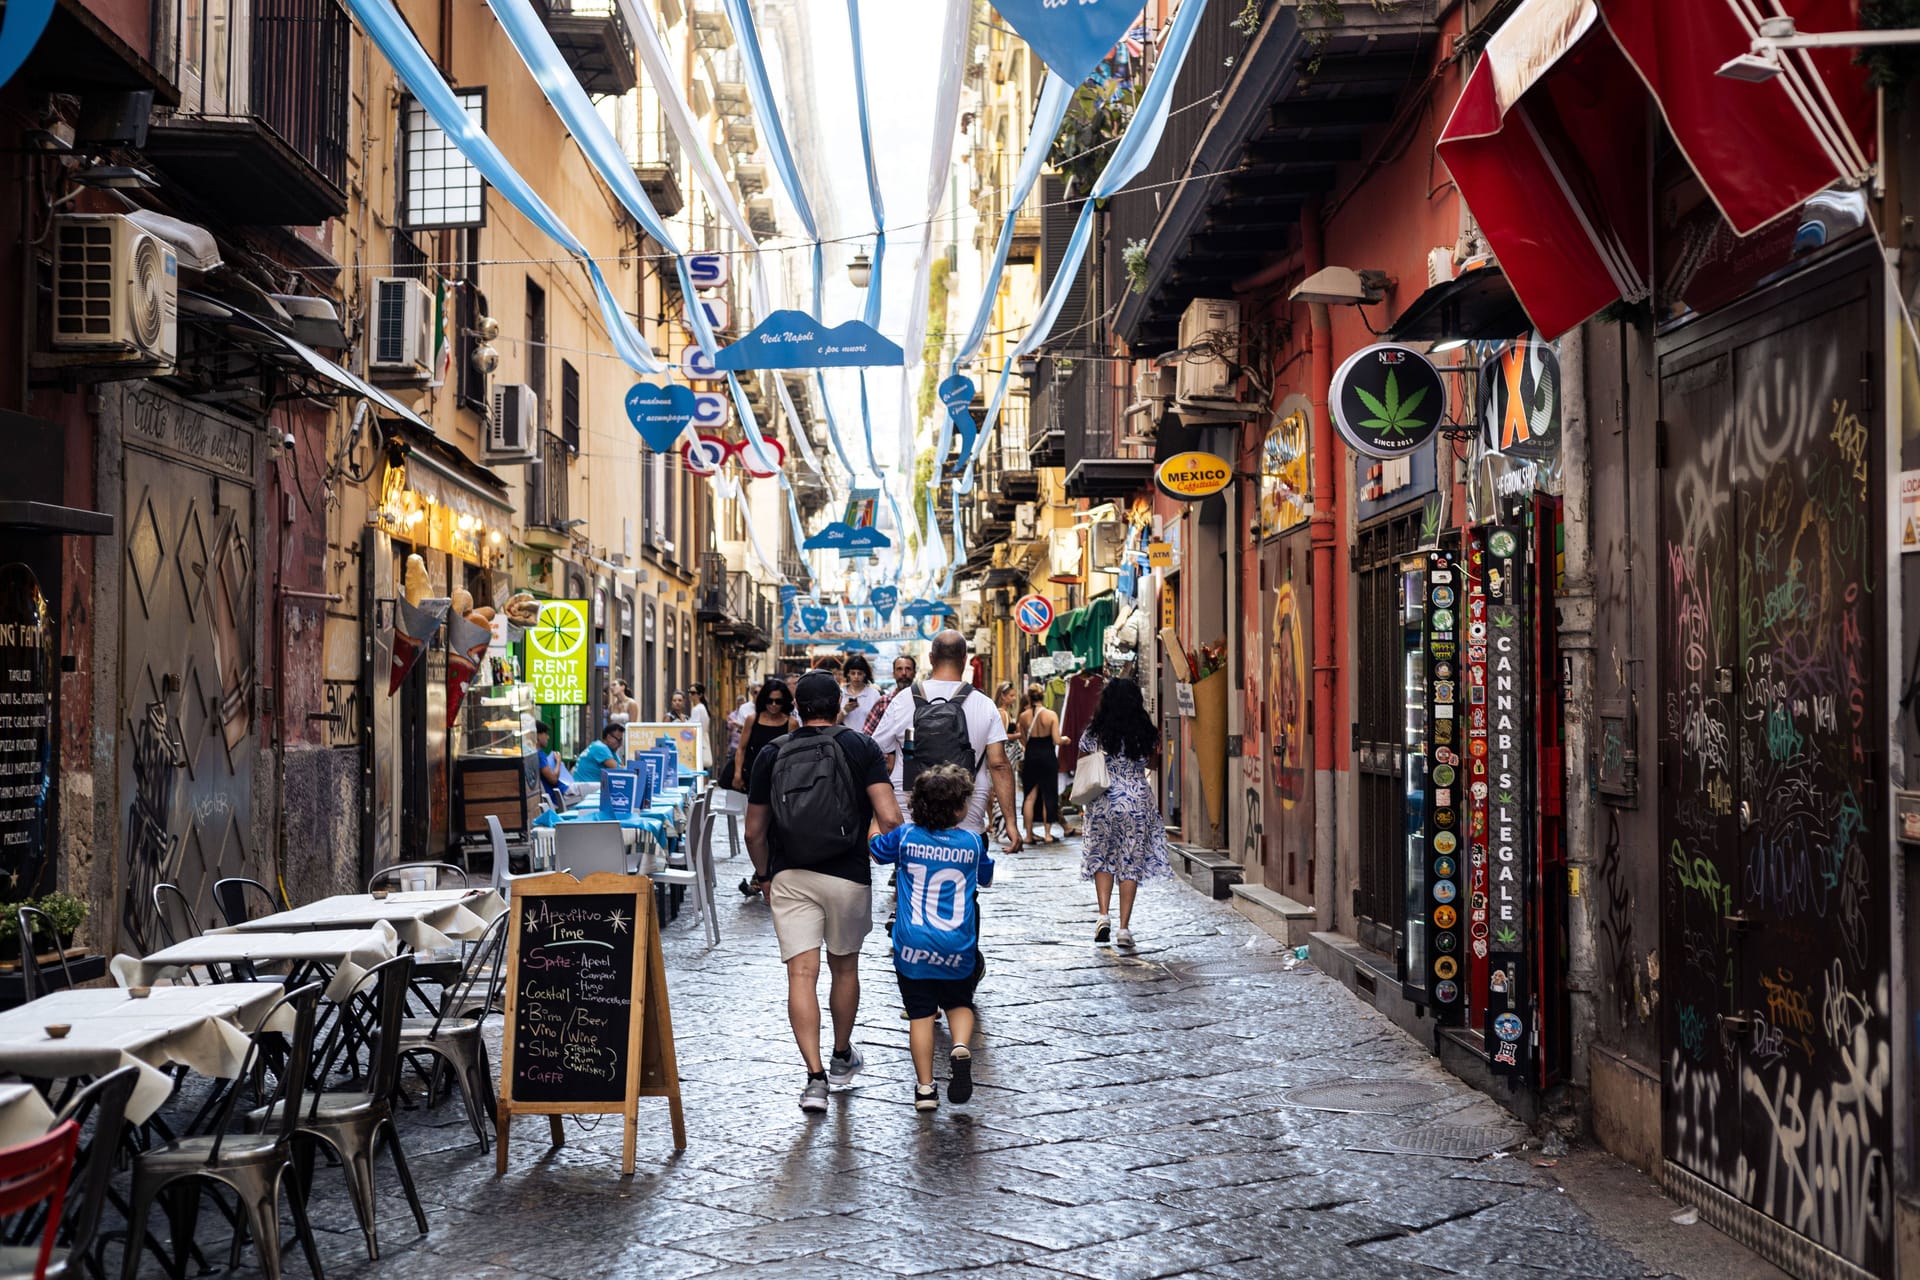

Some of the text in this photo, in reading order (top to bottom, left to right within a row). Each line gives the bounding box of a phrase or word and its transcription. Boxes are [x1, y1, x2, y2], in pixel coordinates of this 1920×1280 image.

[760, 331, 815, 344] Vedi Napoli
[841, 343, 869, 353] muori
[1378, 351, 1406, 362] NXS
[1373, 437, 1396, 448] SINCE
[1168, 469, 1226, 483] MEXICO
[1153, 551, 1171, 559] ATM
[533, 659, 579, 673] RENT
[532, 674, 579, 688] TOUR
[1497, 636, 1512, 789] CANNABIS
[906, 842, 975, 864] MARADONA
[1498, 807, 1513, 920] LEGALE
[907, 863, 967, 931] 10
[540, 899, 602, 924] Aperitivo
[548, 922, 585, 941] Time
[581, 952, 611, 969] Aperol
[580, 968, 617, 981] Campari
[525, 979, 570, 1003] Cocktail
[580, 979, 604, 994] Hugo
[528, 1002, 562, 1023] Birra
[576, 1007, 608, 1027] Beer
[528, 1023, 557, 1039] Vino
[567, 1029, 598, 1047] Wine
[528, 1040, 560, 1059] Shot
[574, 1052, 594, 1065] Rum
[527, 1065, 565, 1084] Caffè
